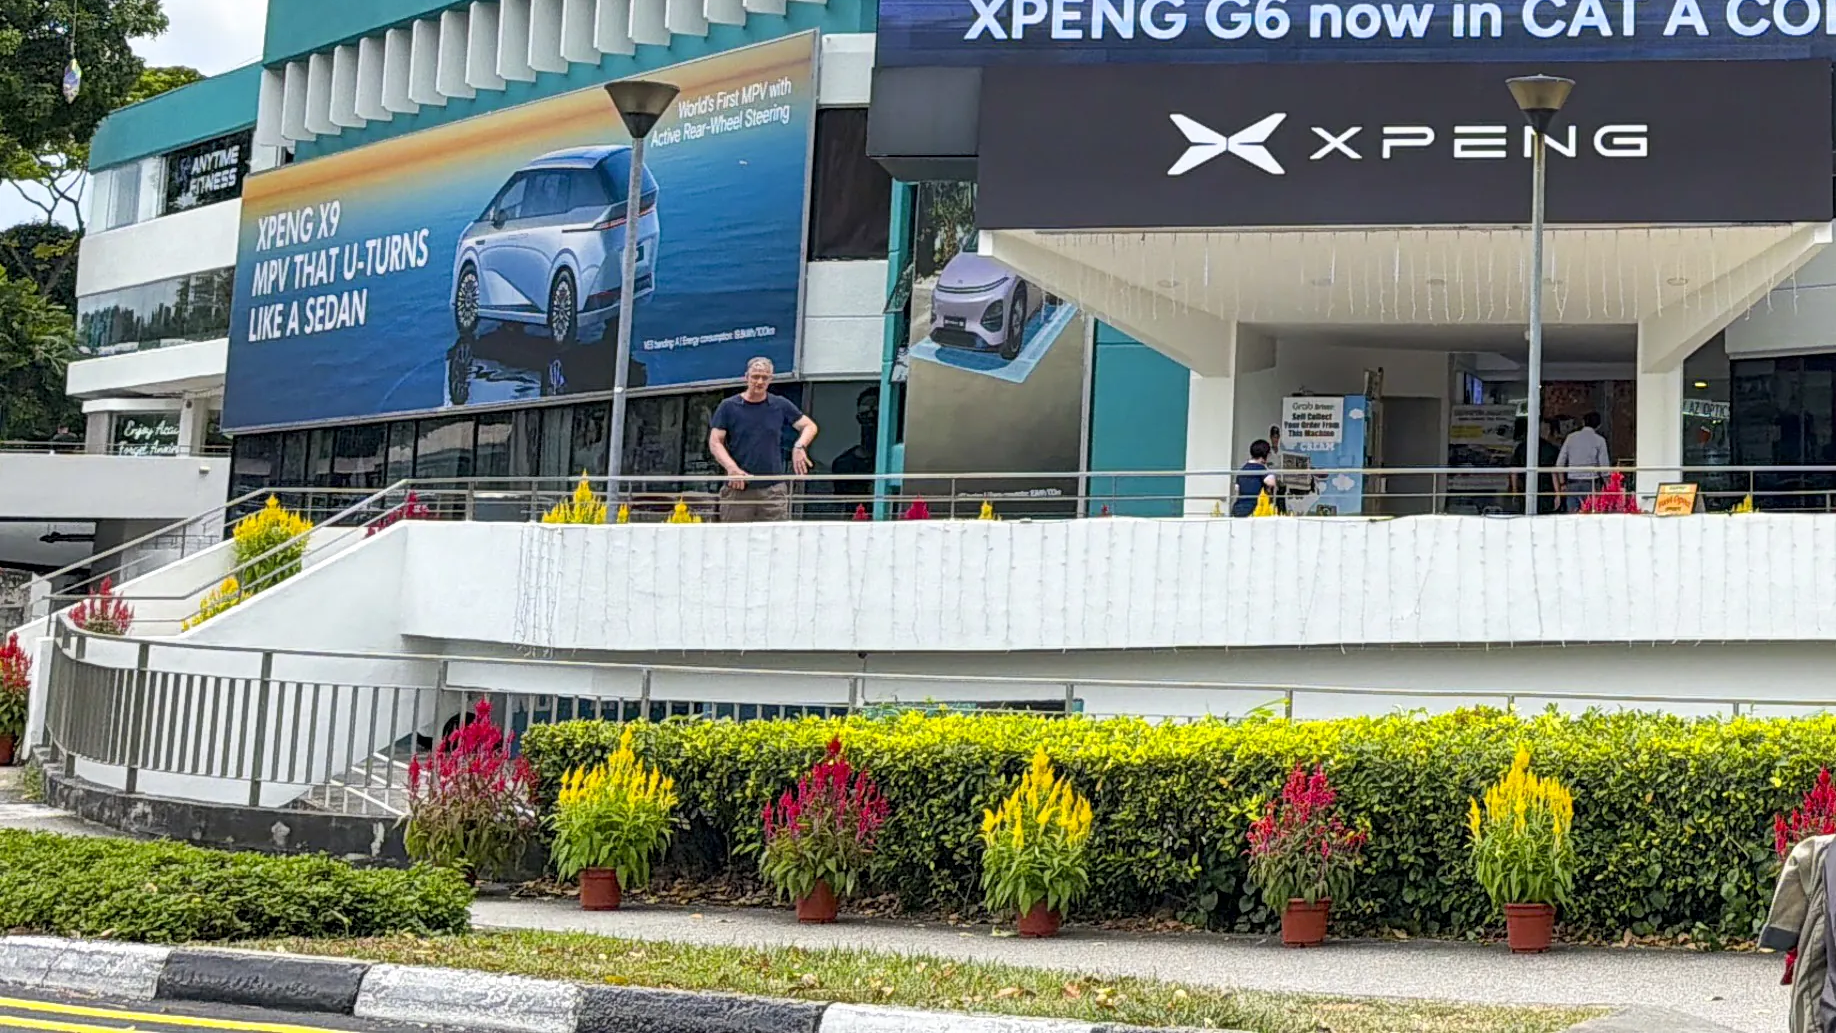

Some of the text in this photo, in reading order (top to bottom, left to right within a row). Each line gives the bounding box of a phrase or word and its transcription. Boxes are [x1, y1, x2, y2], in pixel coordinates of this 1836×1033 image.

[1309, 3, 1435, 39] now
[678, 76, 792, 119] World's First MPV with
[651, 103, 791, 148] Active Rear-Wheel Steering
[1310, 124, 1648, 160] XPENG
[191, 145, 240, 175] ANYTIME
[189, 167, 238, 196] FITNESS
[256, 200, 341, 252] XPENG X9
[252, 228, 430, 297] MPV THAT U-TURNS
[248, 288, 368, 342] LIKE A SEDAN
[124, 420, 154, 440] Enjoy
